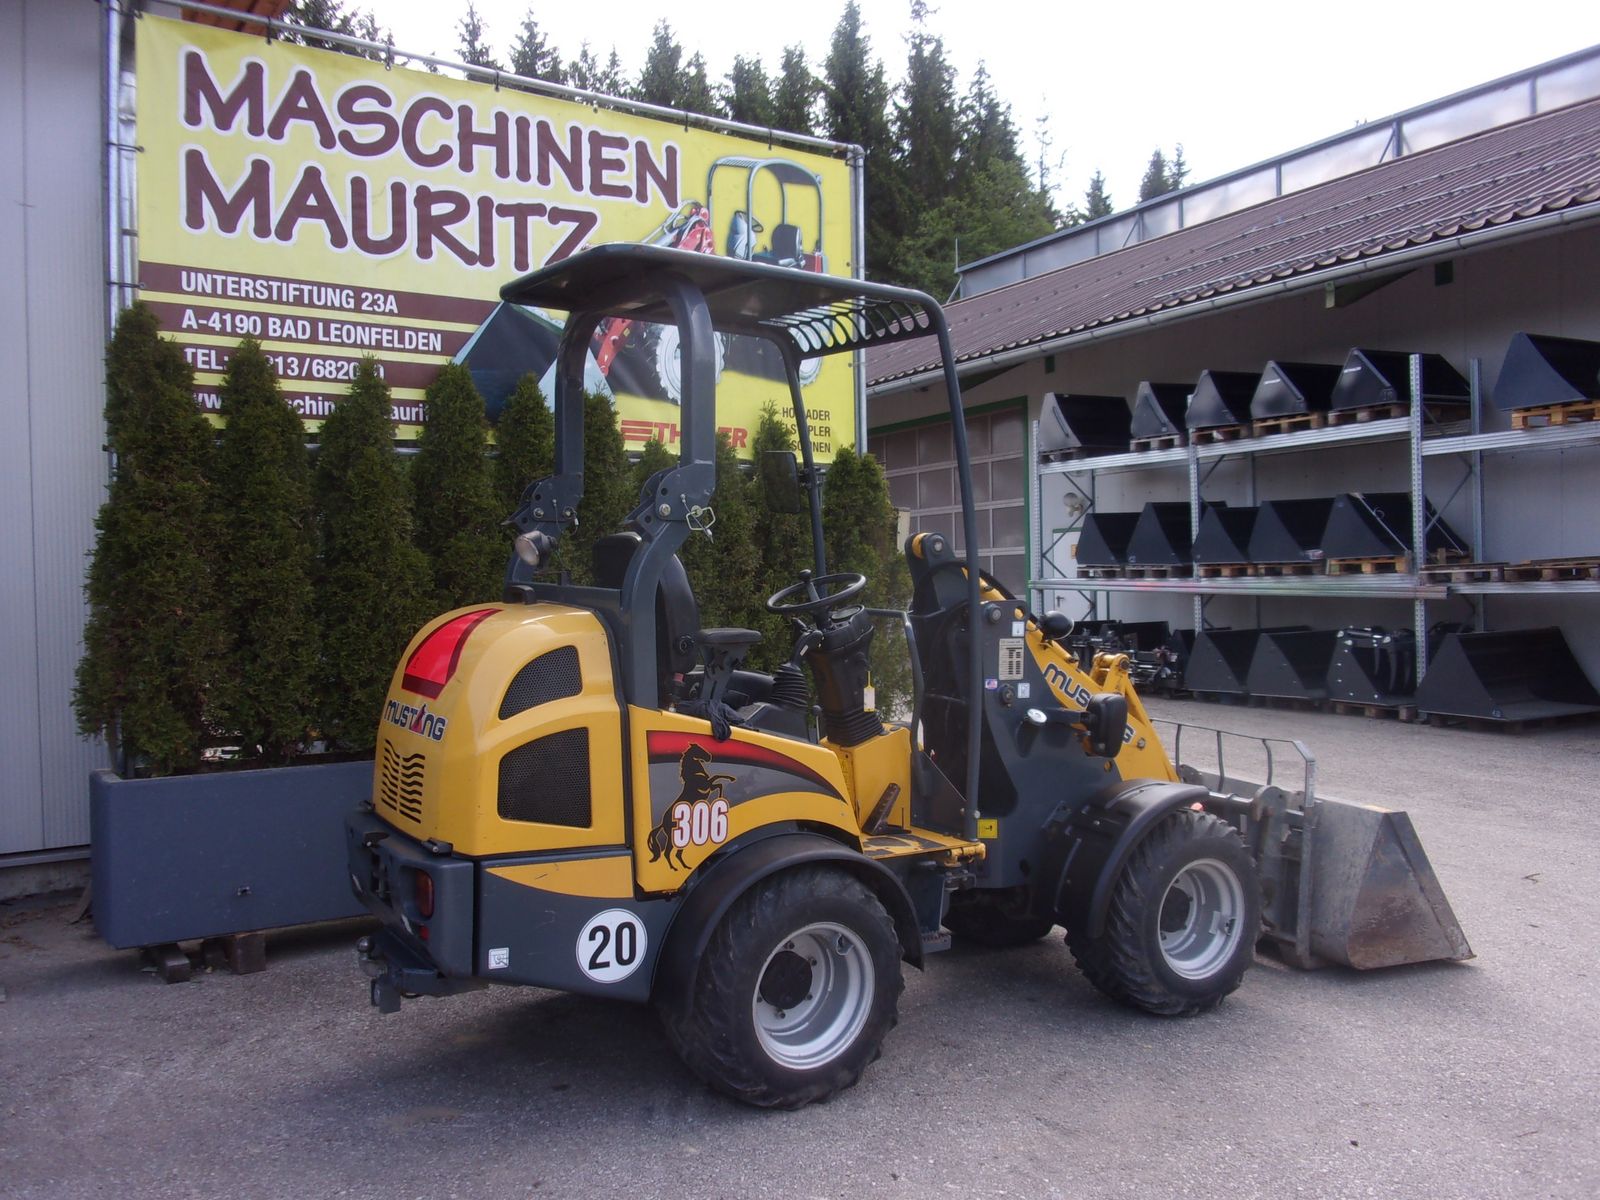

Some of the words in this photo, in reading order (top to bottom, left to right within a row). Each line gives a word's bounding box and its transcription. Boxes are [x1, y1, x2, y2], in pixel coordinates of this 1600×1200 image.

[185, 51, 678, 208] MASCHINEN
[185, 149, 598, 272] MAURITZ
[181, 270, 355, 310] UNTERSTIFTUNG
[360, 291, 399, 314] 23A
[181, 308, 262, 336] A-4190
[268, 317, 311, 341] BAD
[318, 321, 442, 353] LEONFELDEN
[184, 347, 229, 371] TEL:
[782, 406, 831, 422] HOADER
[673, 799, 728, 848] 306
[588, 921, 637, 971] 20
